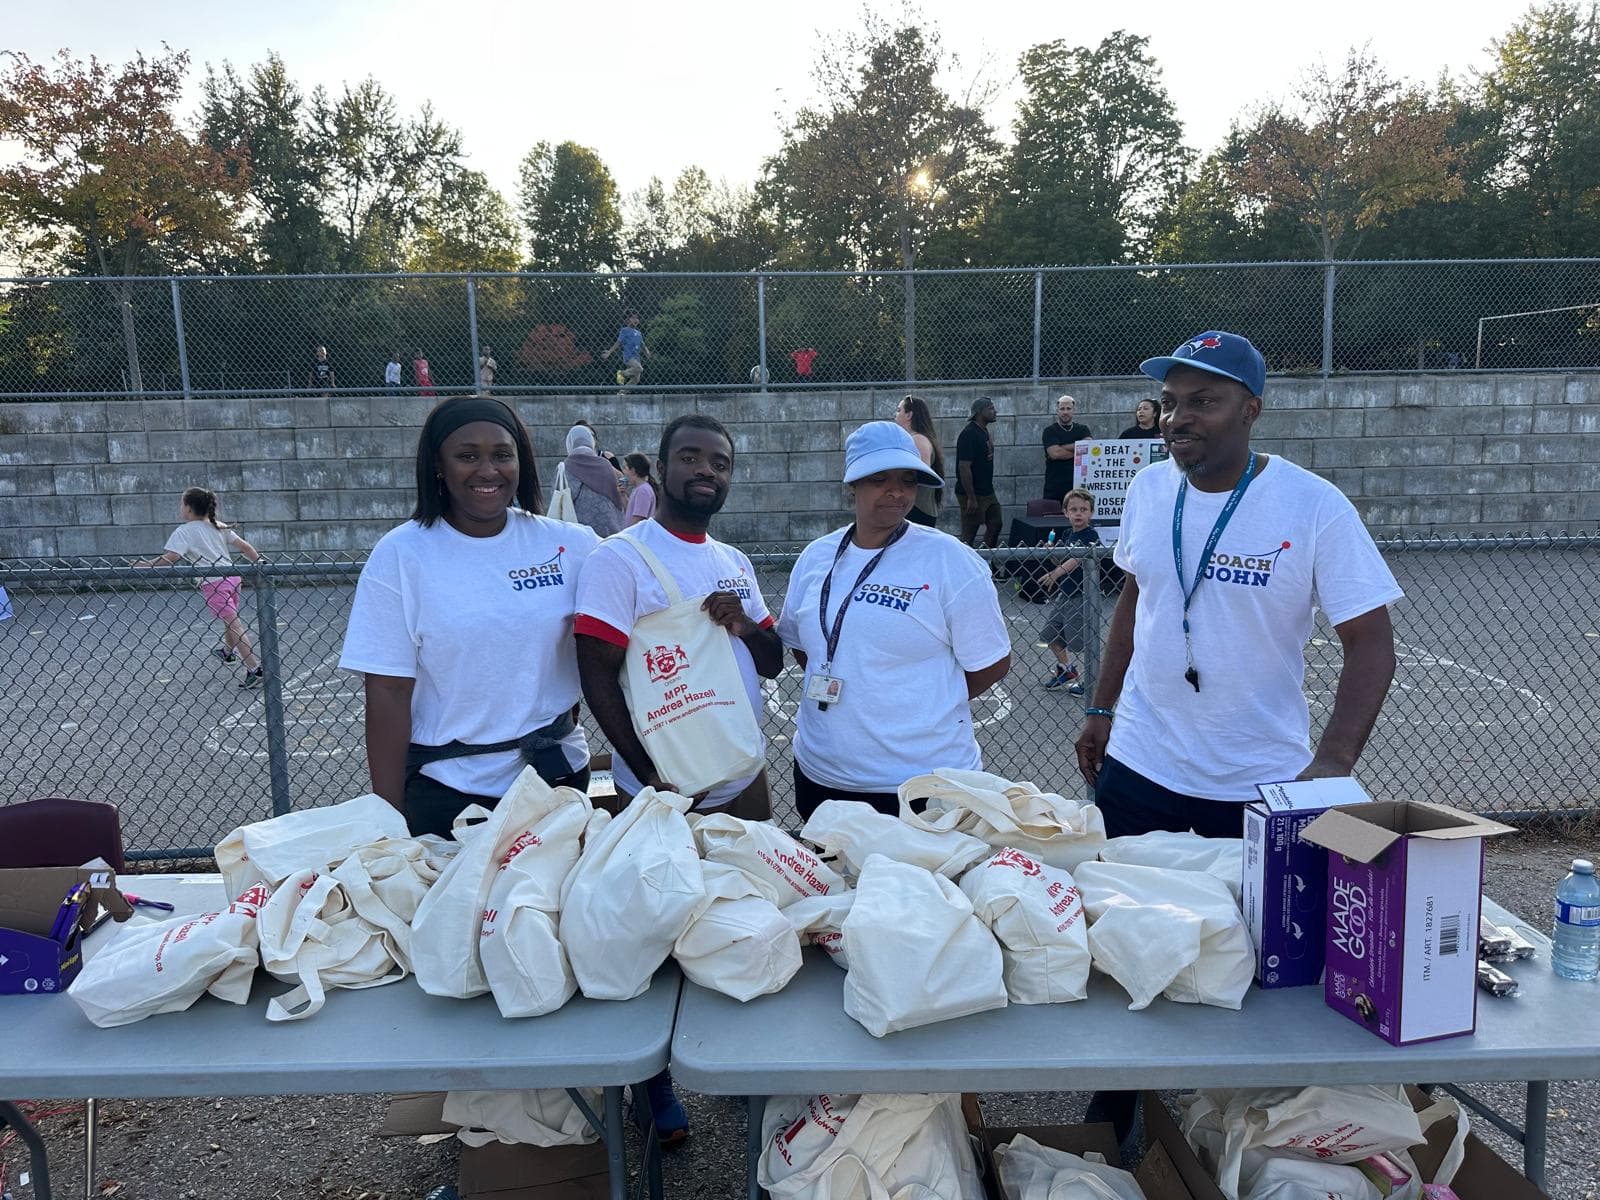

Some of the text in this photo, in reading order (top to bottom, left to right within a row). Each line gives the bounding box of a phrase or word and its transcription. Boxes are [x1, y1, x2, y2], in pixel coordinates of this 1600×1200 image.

[1104, 445, 1130, 455] BEAT
[1106, 458, 1125, 467] THE
[1093, 469, 1137, 478] STREETS
[1087, 481, 1131, 491] WRESTLI
[1097, 497, 1126, 506] JOSEP
[1098, 507, 1123, 516] BRAN
[508, 563, 561, 579] COACH
[1203, 565, 1271, 587] JOHN
[512, 573, 564, 591] JOHN
[717, 578, 751, 590] COACH
[861, 583, 914, 602] COACH
[854, 591, 910, 613] JOHN
[664, 683, 688, 701] MPP
[647, 688, 716, 722] Andrea Hazell
[642, 721, 665, 737] -281-2787
[1277, 817, 1285, 826] 21
[1276, 833, 1284, 846] 100
[796, 848, 818, 869] MPP
[803, 870, 830, 897] Hazell
[1331, 876, 1350, 953] MADE
[1348, 886, 1367, 959] GOOD
[1425, 895, 1434, 932] 1827681
[775, 1132, 792, 1166] OCAL
